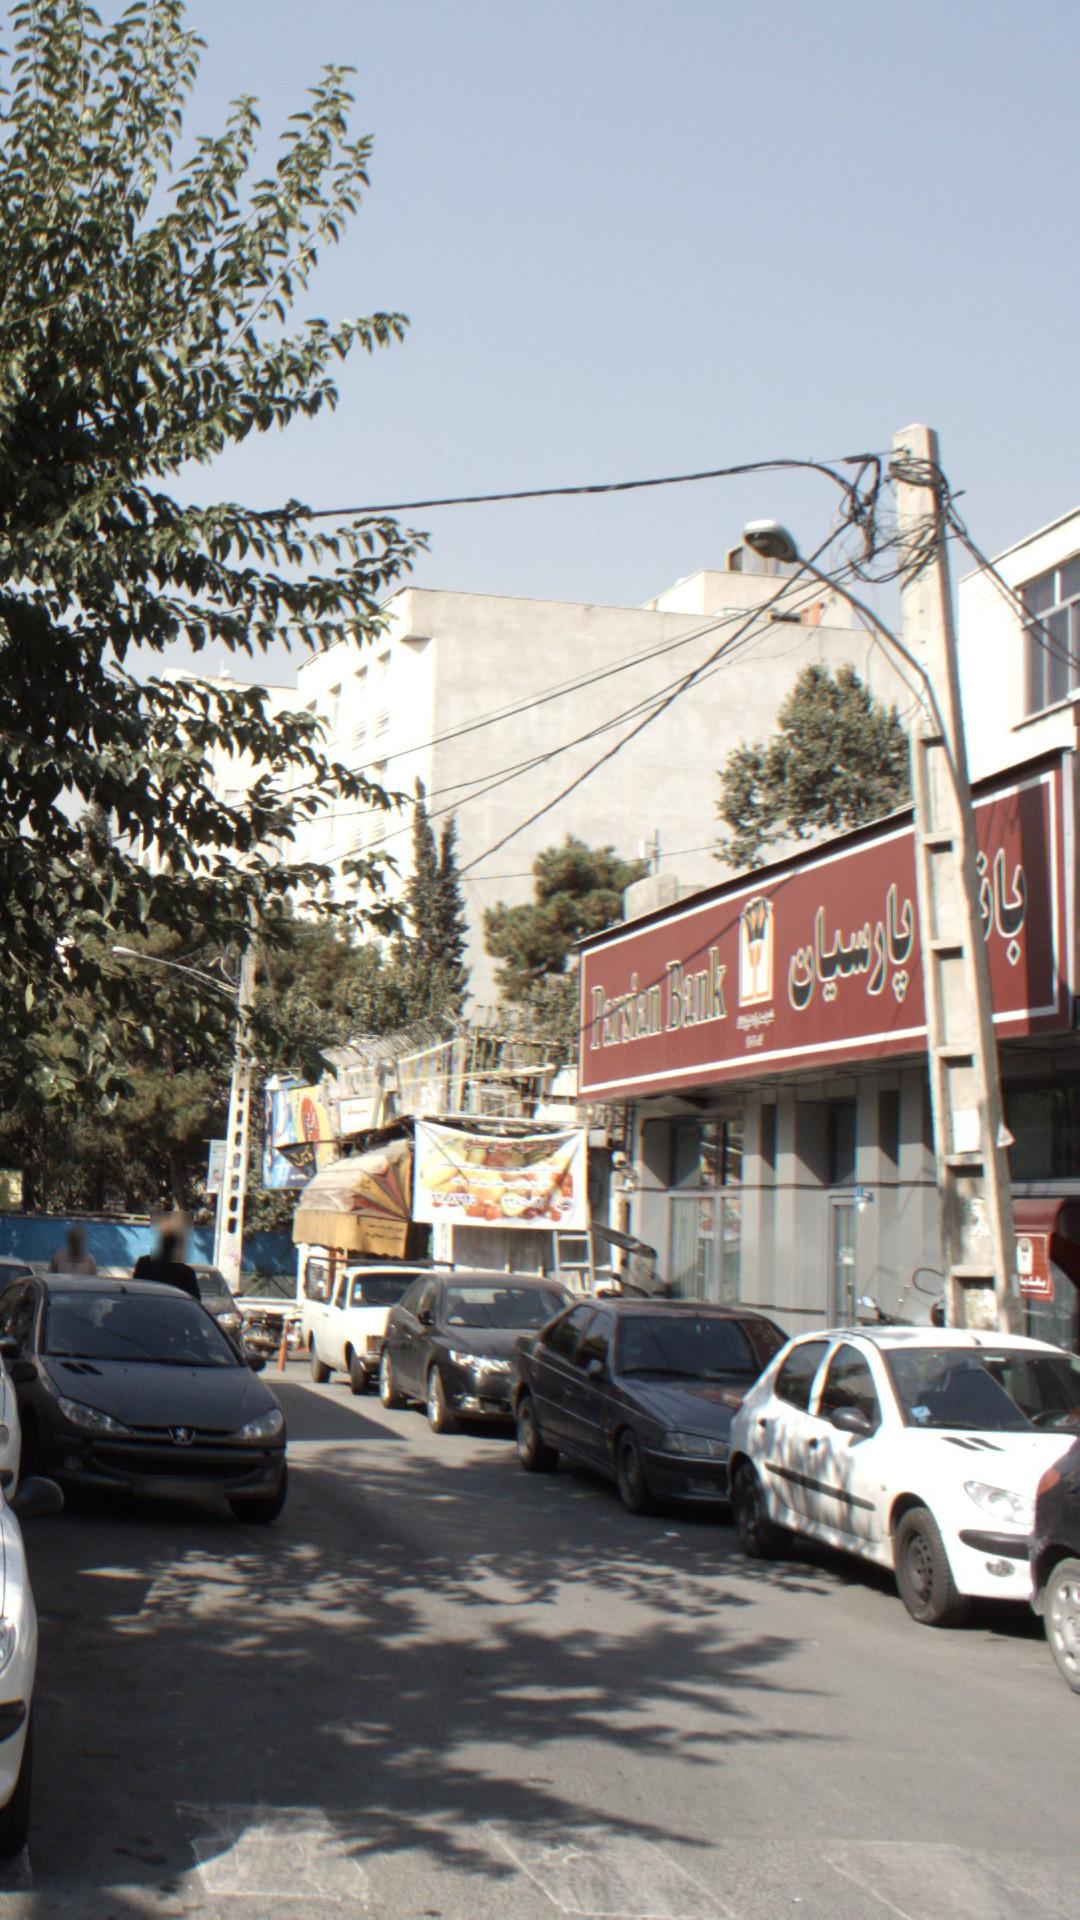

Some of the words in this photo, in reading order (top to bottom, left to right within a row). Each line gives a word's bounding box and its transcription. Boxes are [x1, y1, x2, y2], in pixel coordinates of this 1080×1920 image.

[788, 882, 914, 1010] پارسیان
[975, 847, 1027, 966] بان
[590, 972, 662, 1050] Parsian
[665, 946, 727, 1032] Bank
